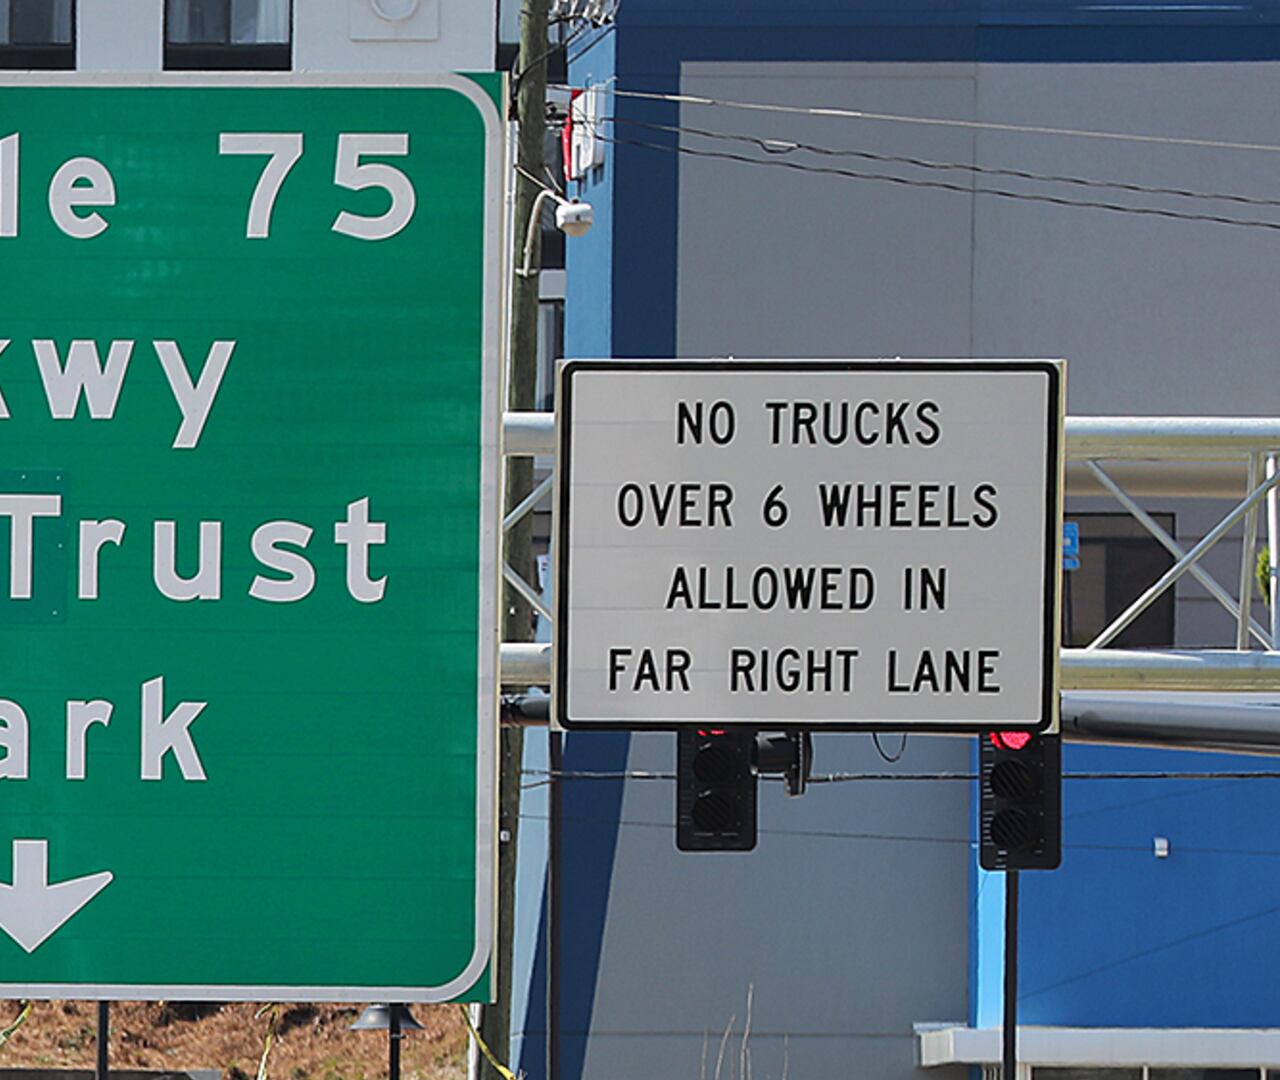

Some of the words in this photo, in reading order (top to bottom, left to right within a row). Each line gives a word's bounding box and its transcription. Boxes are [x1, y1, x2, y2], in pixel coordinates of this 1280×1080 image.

[218, 131, 417, 241] 75
[676, 401, 736, 446] NO
[765, 401, 941, 446] TRUCKS
[617, 483, 734, 528] OVER
[762, 483, 789, 528] 6
[818, 484, 999, 528] WHEELS
[666, 566, 875, 610] ALLOWED
[904, 566, 947, 610] IN
[608, 648, 692, 693] FAR
[729, 648, 860, 693] RIGHT
[888, 650, 1002, 693] LANE
